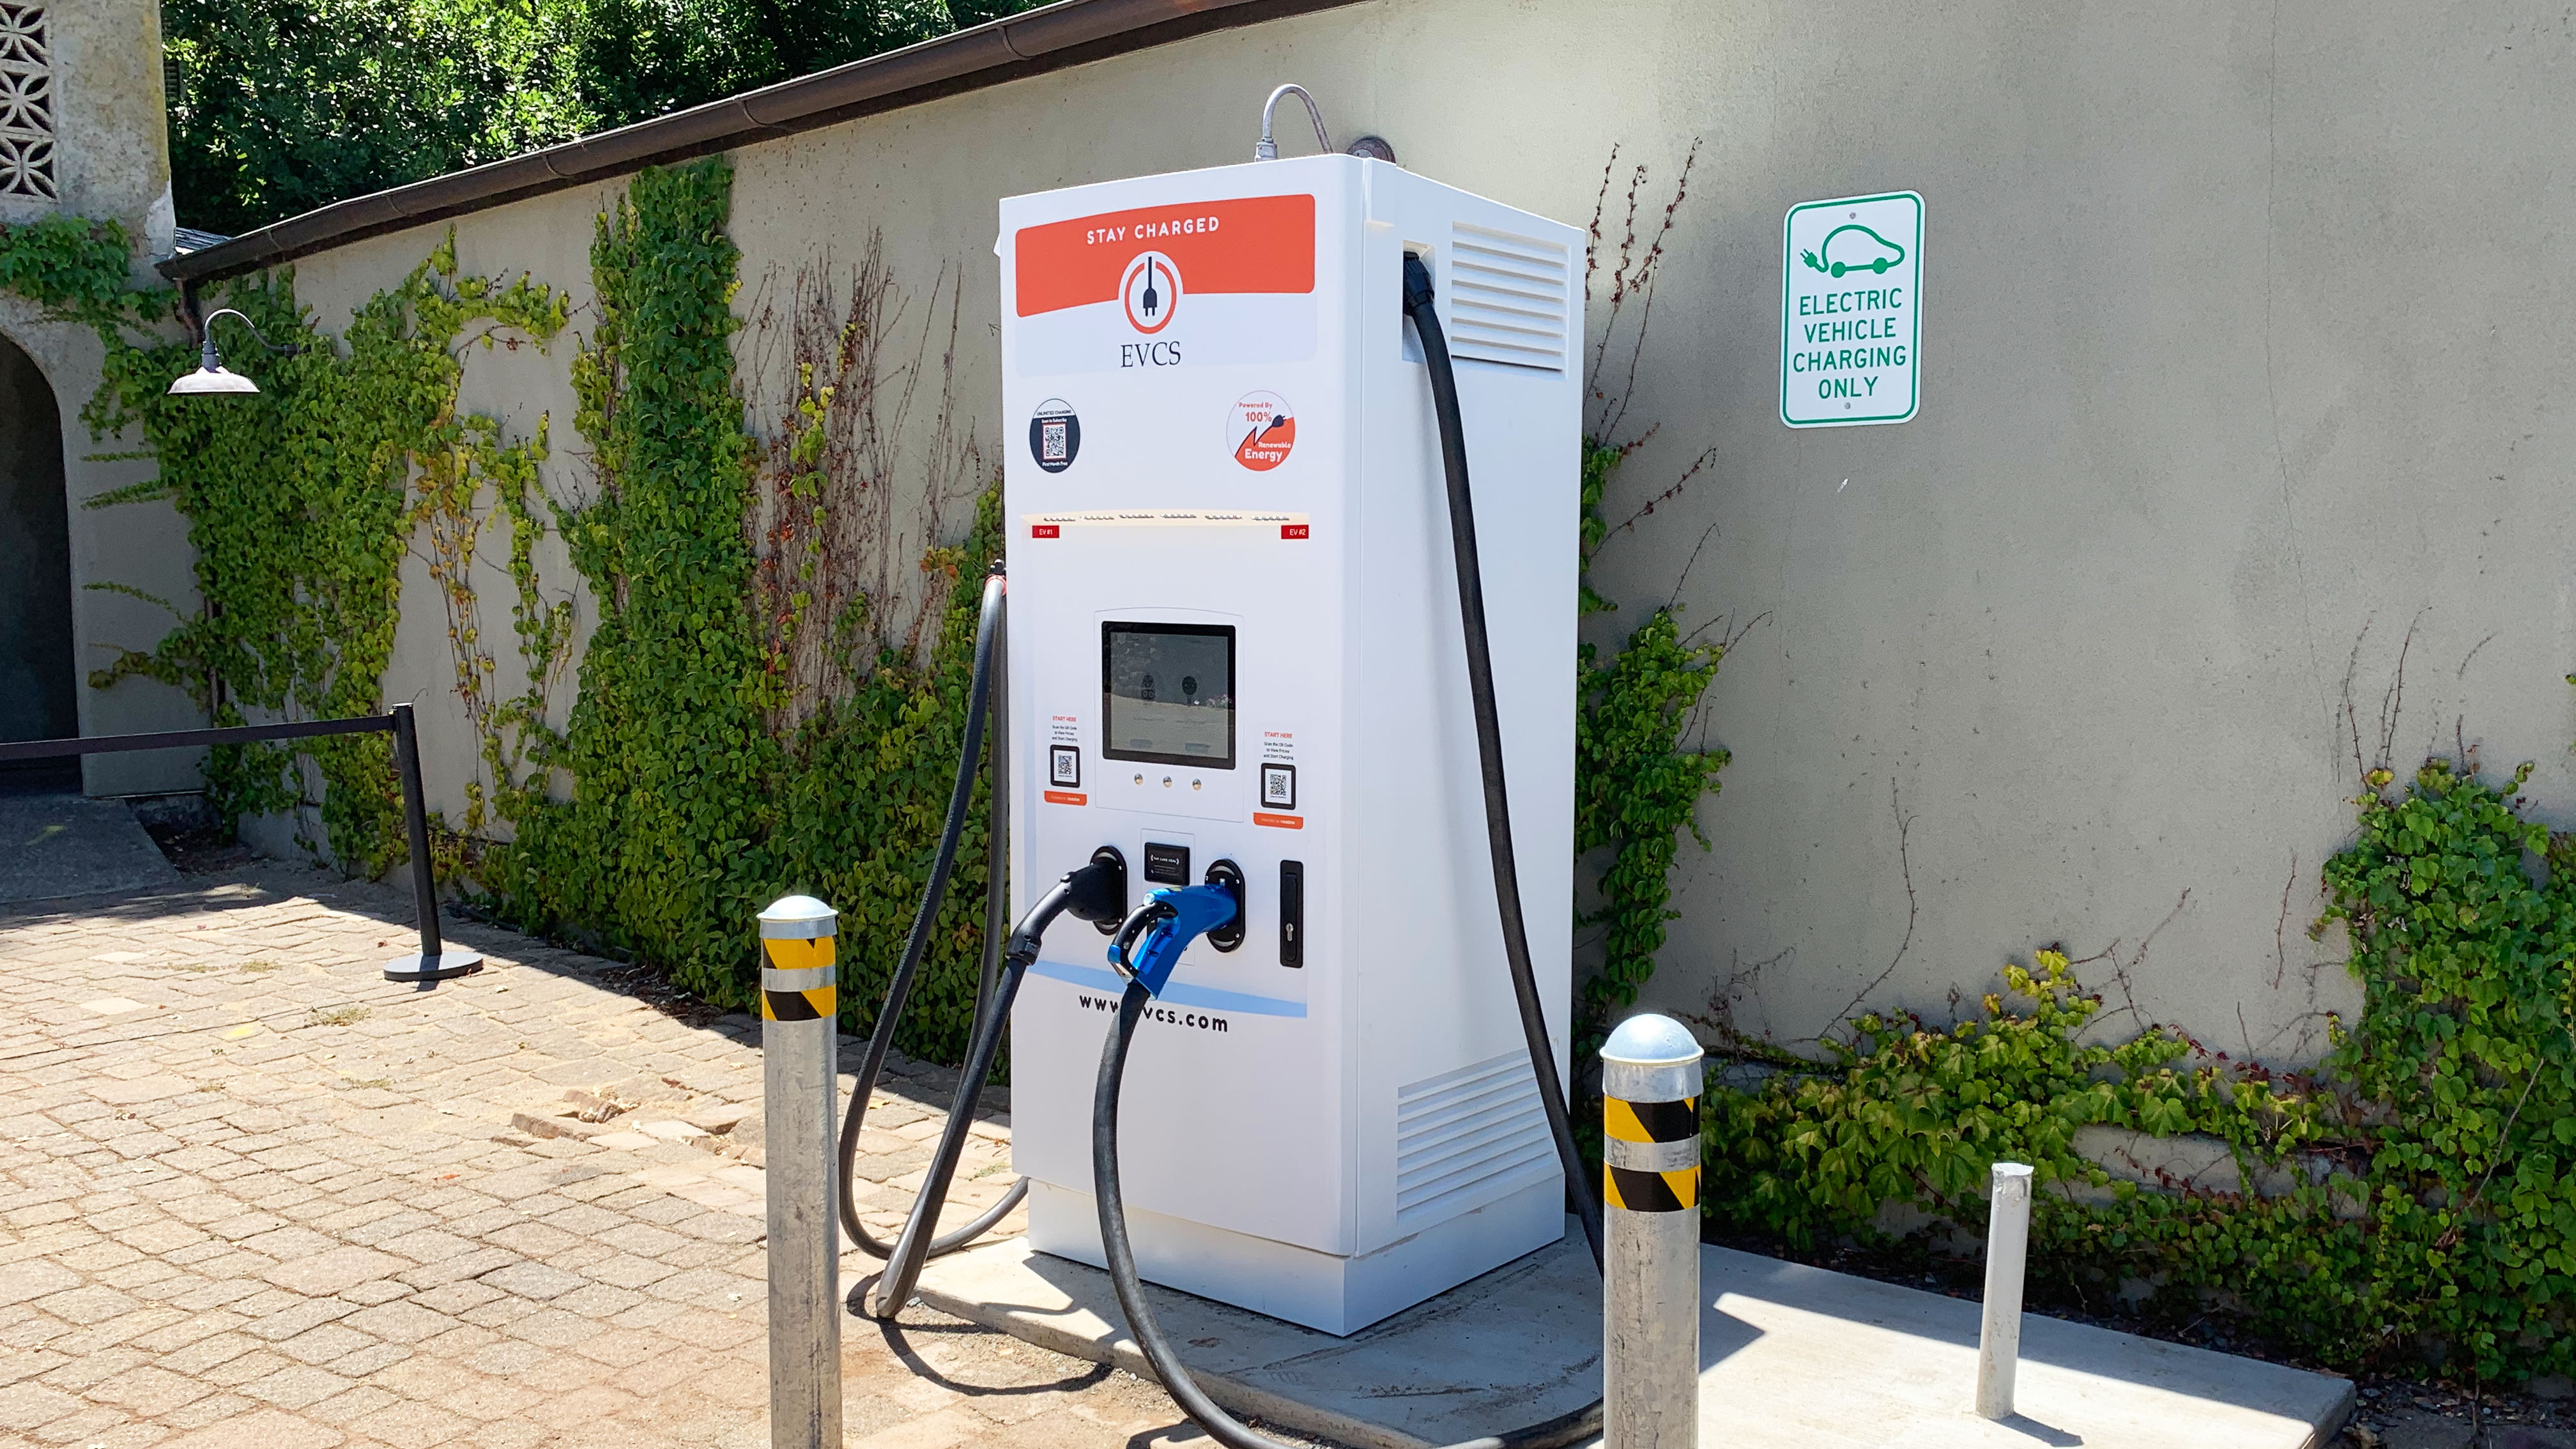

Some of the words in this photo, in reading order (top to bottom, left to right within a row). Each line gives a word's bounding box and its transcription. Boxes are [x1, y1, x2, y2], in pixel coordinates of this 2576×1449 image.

[1087, 226, 1126, 245] STAY
[1135, 217, 1219, 239] CHARGED
[1800, 288, 1902, 316] ELECTRIC
[1804, 318, 1896, 343] VEHICLE
[1121, 341, 1181, 367] EVCS
[1793, 346, 1906, 372] CHARGING
[1818, 376, 1878, 399] ONLY
[1245, 411, 1272, 422] 100%
[1245, 448, 1283, 462] Energy
[1079, 995, 1228, 1032] wwwvcs.com
